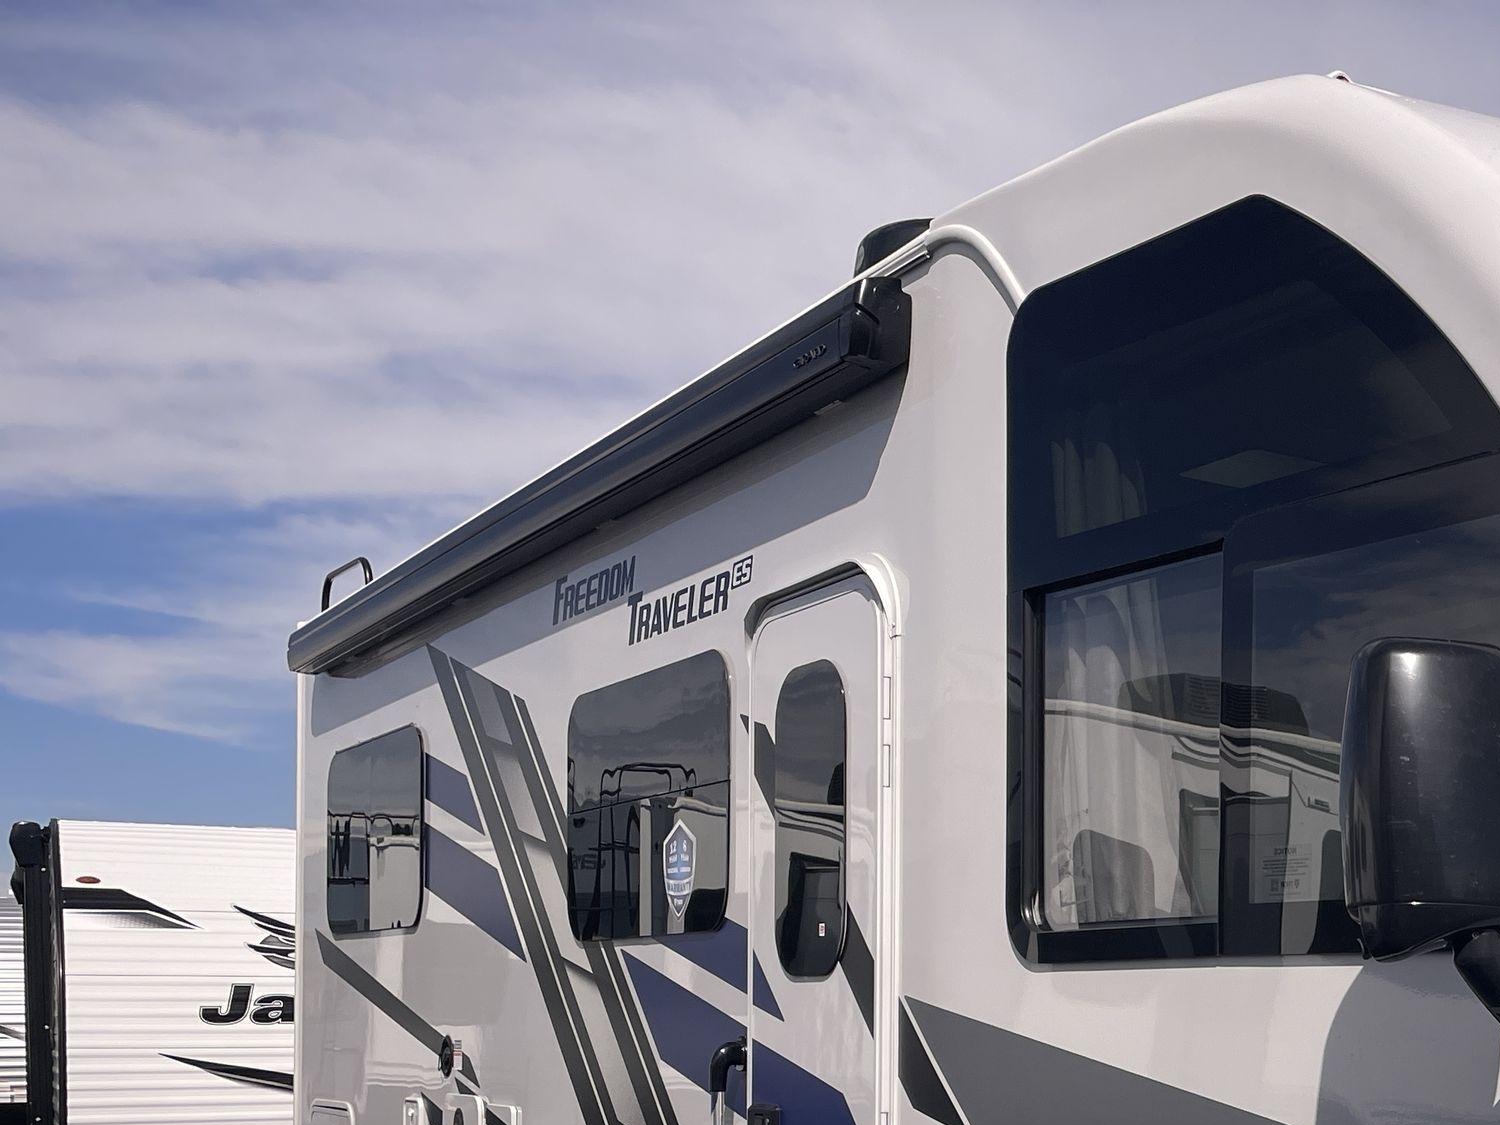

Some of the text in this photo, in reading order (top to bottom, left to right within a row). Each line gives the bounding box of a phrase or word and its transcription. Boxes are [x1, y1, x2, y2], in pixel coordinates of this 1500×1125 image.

[552, 556, 636, 626] FREEDOM
[627, 555, 754, 646] TRAVELER ES
